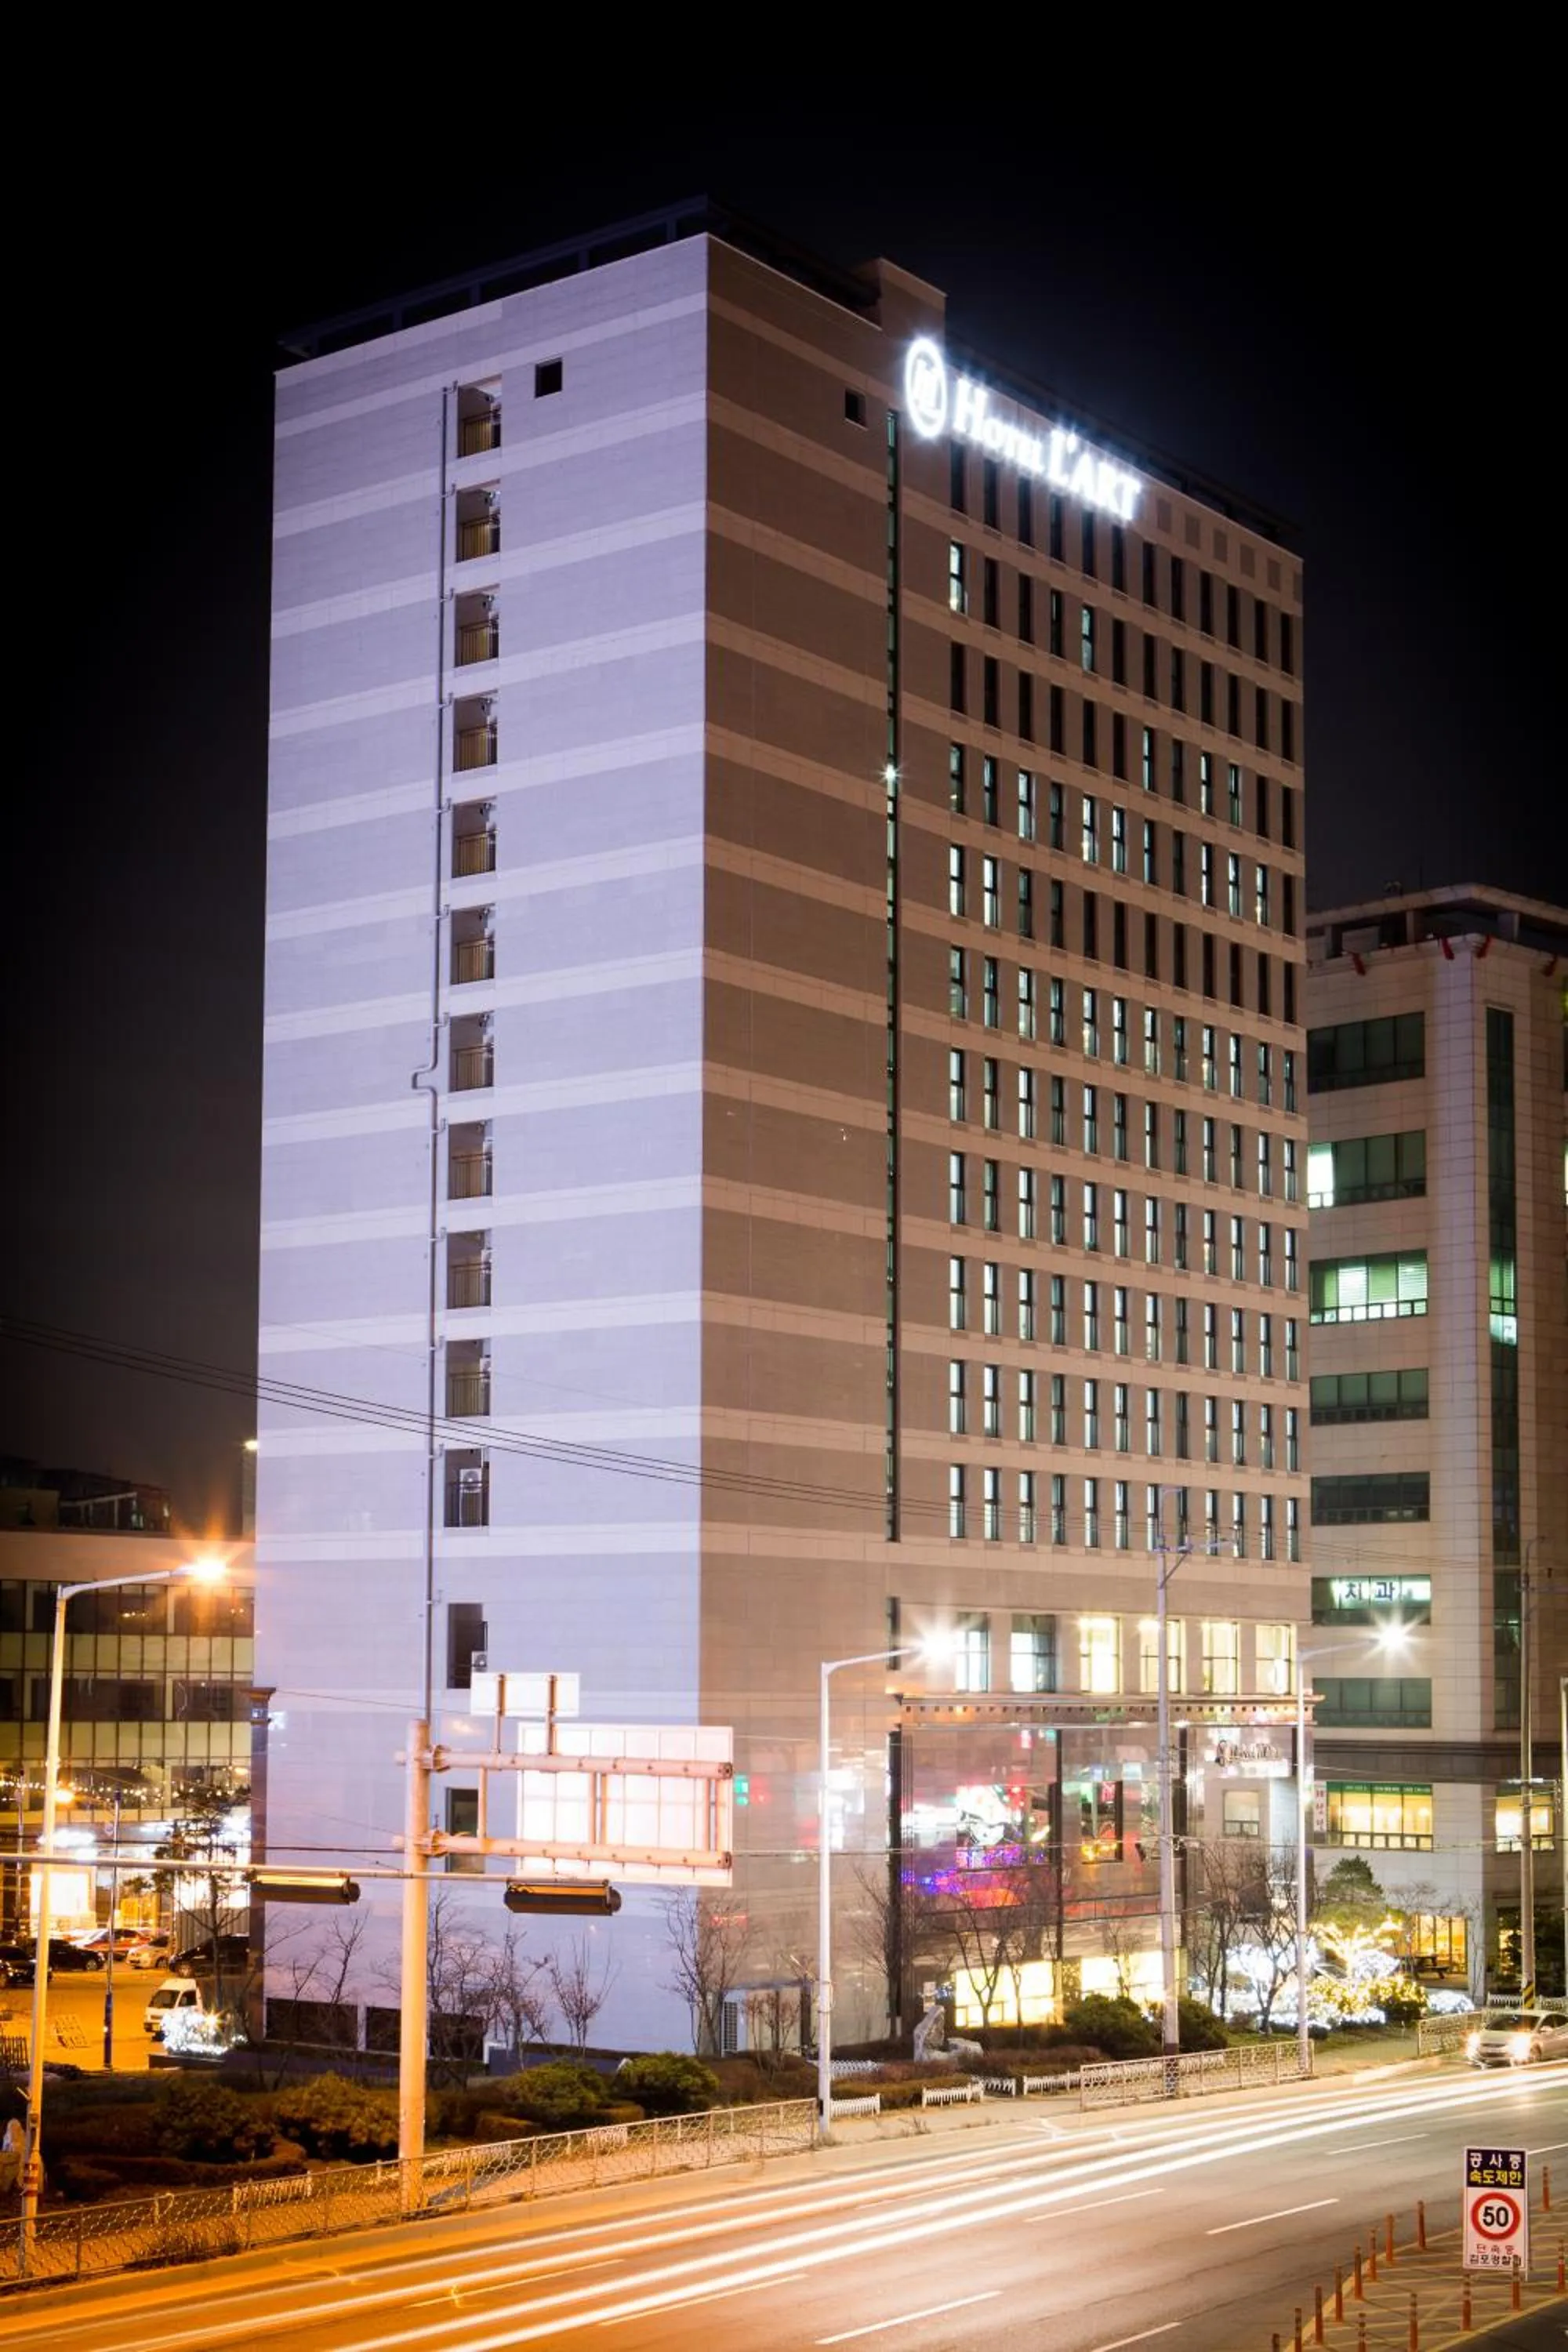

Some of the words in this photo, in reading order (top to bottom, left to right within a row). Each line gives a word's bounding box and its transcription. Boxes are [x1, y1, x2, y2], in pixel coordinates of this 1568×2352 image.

[1345, 1581, 1396, 1602] 치과
[1470, 2169, 1522, 2186] 속도제한
[1483, 2206, 1509, 2227] 50
